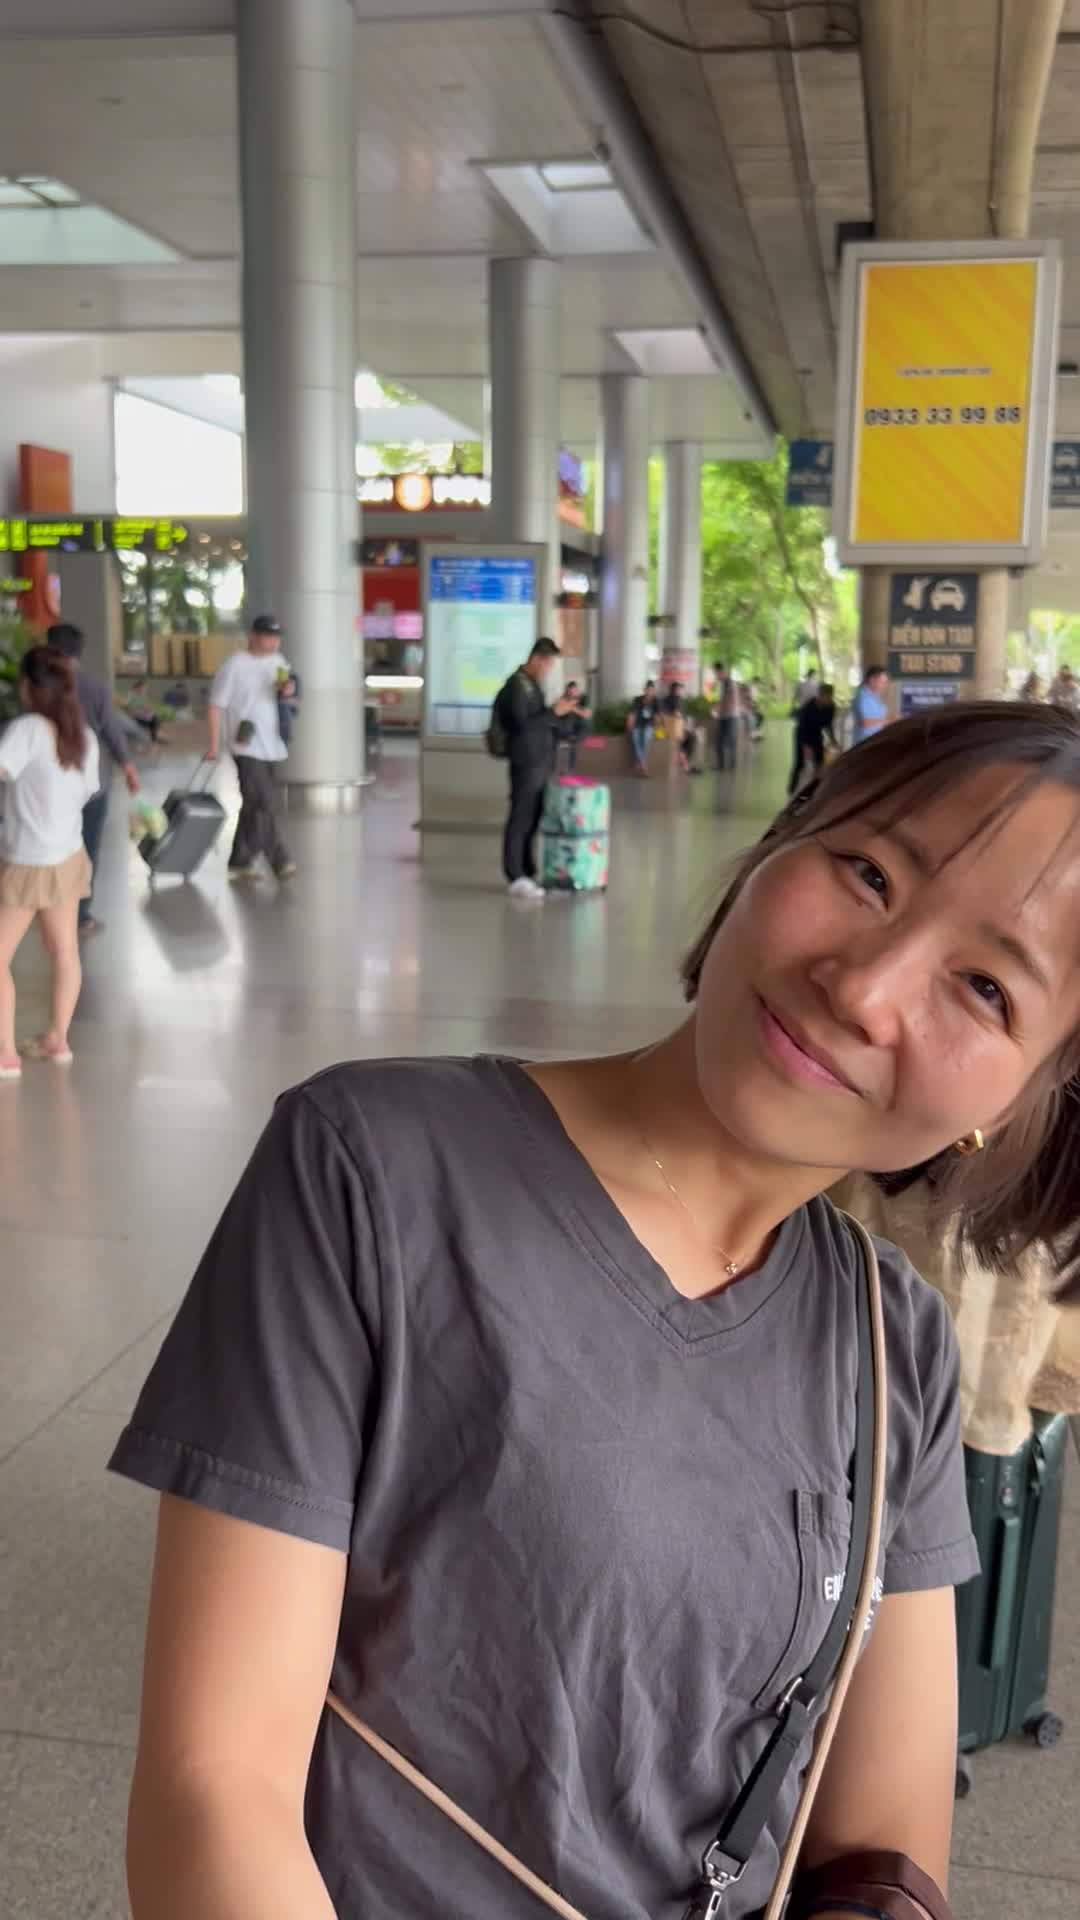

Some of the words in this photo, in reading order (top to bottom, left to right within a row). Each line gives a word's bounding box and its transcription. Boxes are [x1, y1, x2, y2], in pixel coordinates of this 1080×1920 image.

[864, 408, 919, 425] 0933
[926, 408, 952, 424] 33
[960, 407, 986, 424] 99
